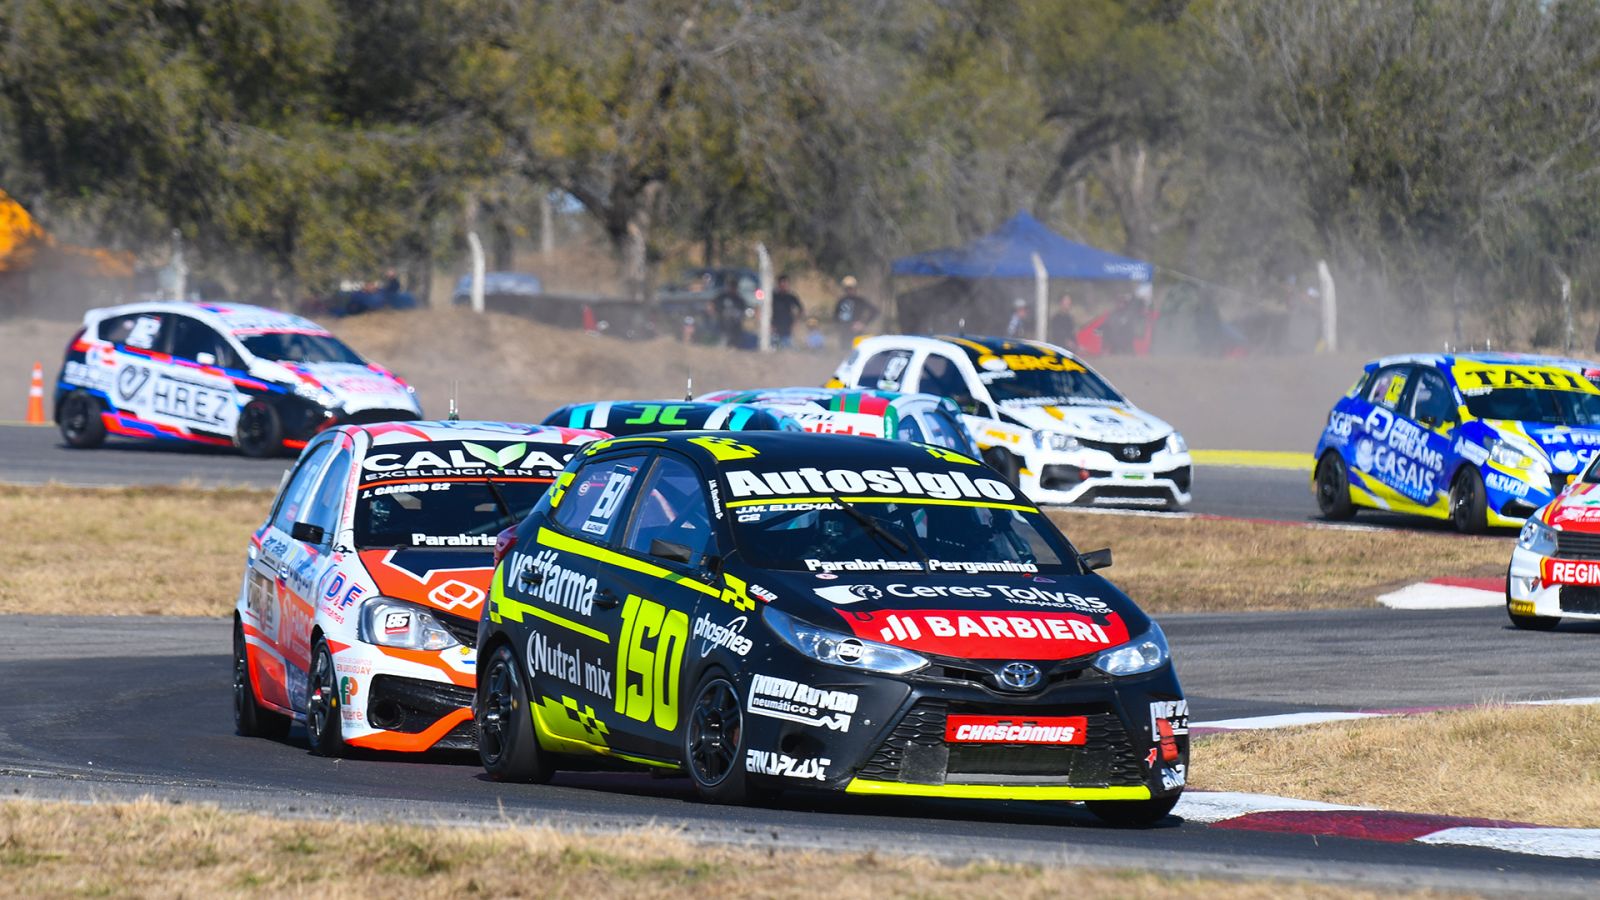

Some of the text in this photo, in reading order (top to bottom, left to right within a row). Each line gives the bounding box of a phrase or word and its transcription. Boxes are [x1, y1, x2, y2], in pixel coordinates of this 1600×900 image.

[1465, 370, 1581, 389] TATI
[363, 441, 574, 471] CALVA
[365, 468, 499, 481] EXCELENCIA
[504, 468, 533, 477] EN
[725, 467, 1015, 501] Autosiglo
[1375, 445, 1435, 497] CASAIS
[736, 505, 767, 514] J.M.
[804, 558, 1039, 574] Parabrisas Pergamino
[886, 583, 1108, 609] Ceres Tolvas
[923, 616, 1110, 643] BARBIERI
[534, 635, 612, 700] Nutral mix
[615, 593, 689, 731] 150
[753, 697, 818, 717] neumáticos
[956, 724, 1076, 743] CHASCOMUS
